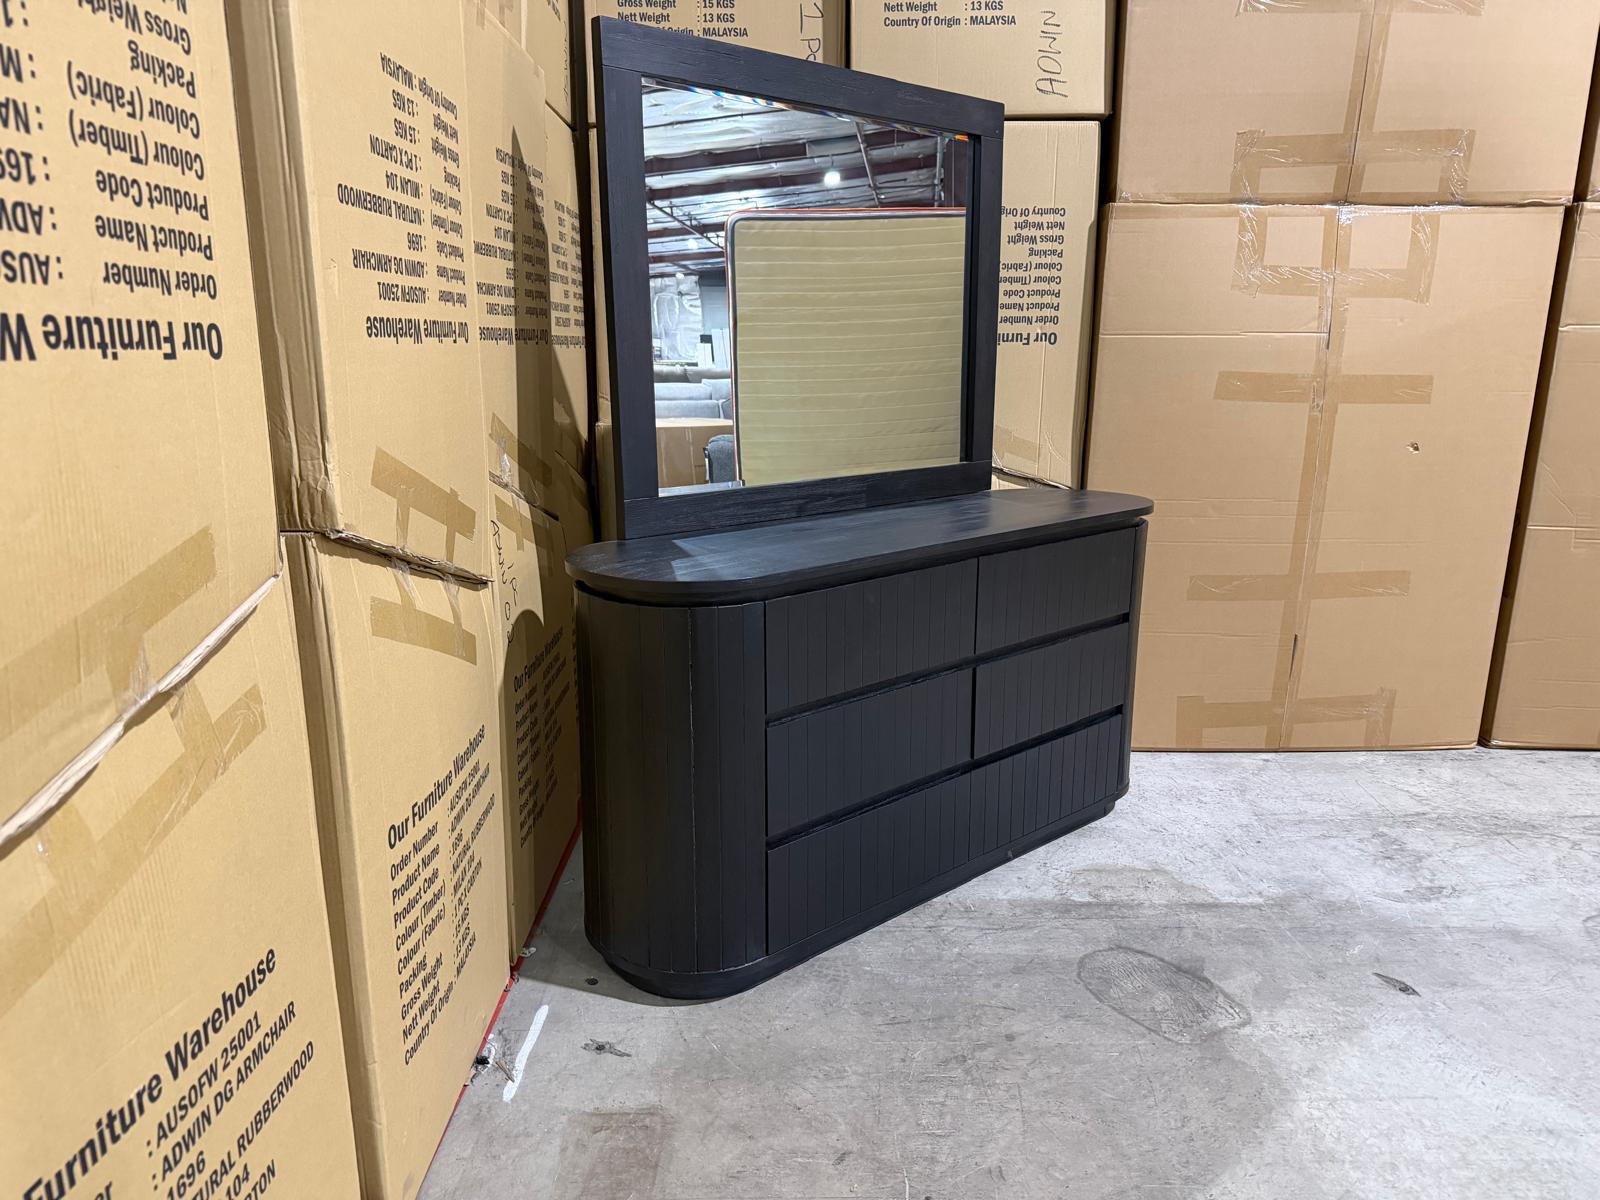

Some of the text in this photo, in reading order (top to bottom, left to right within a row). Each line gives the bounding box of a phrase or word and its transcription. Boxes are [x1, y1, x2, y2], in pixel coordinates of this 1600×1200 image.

[617, 0, 735, 10] Gross Weight 15 KGS
[617, 12, 735, 24] Nett Weight 13 KGS
[884, 0, 1004, 13] Nett Weight 13 KGS
[78, 0, 191, 55] Gross Weig
[702, 27, 749, 37] MALAYSIA
[884, 15, 1016, 28] Country Of Origin MALAYSIA
[128, 40, 196, 98] Packing
[380, 52, 414, 90] MALAYSIA
[67, 60, 143, 122] (Fabric)
[392, 89, 414, 117] 13 KGS
[148, 98, 200, 139] Colour
[394, 118, 416, 144] 15 KGS
[69, 109, 148, 166] (Timber)
[370, 134, 398, 164] CARTON
[154, 141, 204, 180] Colour
[398, 147, 403, 166] X
[402, 149, 413, 170] PC
[414, 154, 418, 172] 1
[96, 170, 142, 207] Code
[386, 170, 398, 192] 104
[400, 176, 420, 199] MILAN
[146, 182, 209, 221] Product
[338, 183, 392, 217] RUBBERWOOD
[393, 200, 422, 226] NATURAL
[1001, 206, 1066, 217] Country Of Orig
[95, 215, 213, 261] Product Name
[1007, 233, 1064, 245] Gross Weight
[1014, 220, 1065, 231] Nett Weight
[407, 232, 423, 252] 1696
[1028, 247, 1063, 258] Packing
[352, 248, 392, 274] ARMCHAIR
[394, 256, 403, 275] DG
[404, 258, 424, 278] ADWIN
[1034, 262, 1062, 271] Colour
[103, 262, 172, 296] Number
[175, 271, 217, 300] Order
[377, 282, 399, 302] 25001
[1003, 289, 1060, 298] Product Code
[1033, 275, 1061, 285] Colour
[401, 285, 426, 304] AUSOFW
[999, 302, 1059, 311] Product Name
[366, 316, 468, 344] Our Furniture Warehouse
[999, 315, 1059, 325] Order Number
[42, 314, 177, 360] Furniture
[182, 322, 222, 360] Our
[1033, 332, 1058, 346] Our
[388, 724, 484, 849] Our Furniture Warehouse
[391, 850, 412, 881] Order
[413, 822, 438, 858] Number
[392, 862, 420, 906] Product
[422, 844, 439, 872] Name
[394, 886, 422, 929] Product
[423, 868, 439, 894] Code
[396, 916, 418, 952] Colour
[420, 879, 445, 925] (Timber)
[398, 938, 420, 975] Colour
[422, 902, 445, 947] (Fabric)
[400, 952, 427, 999] Packing
[402, 987, 421, 1020] Gross
[421, 952, 442, 992] Weight
[403, 1013, 418, 1044] Nett
[418, 975, 440, 1020] Weight
[405, 1020, 429, 1065] Country
[431, 1004, 437, 1024] Of
[438, 981, 453, 1012] Origin
[23, 948, 276, 1200] Furniture Warehouse
[157, 1011, 262, 1149] AUSOFW 25001
[162, 1000, 297, 1182] ADWIN DG ARMCHAIR
[237, 1041, 314, 1158] RUBBERWOOD
[167, 1150, 206, 1200] 1696
